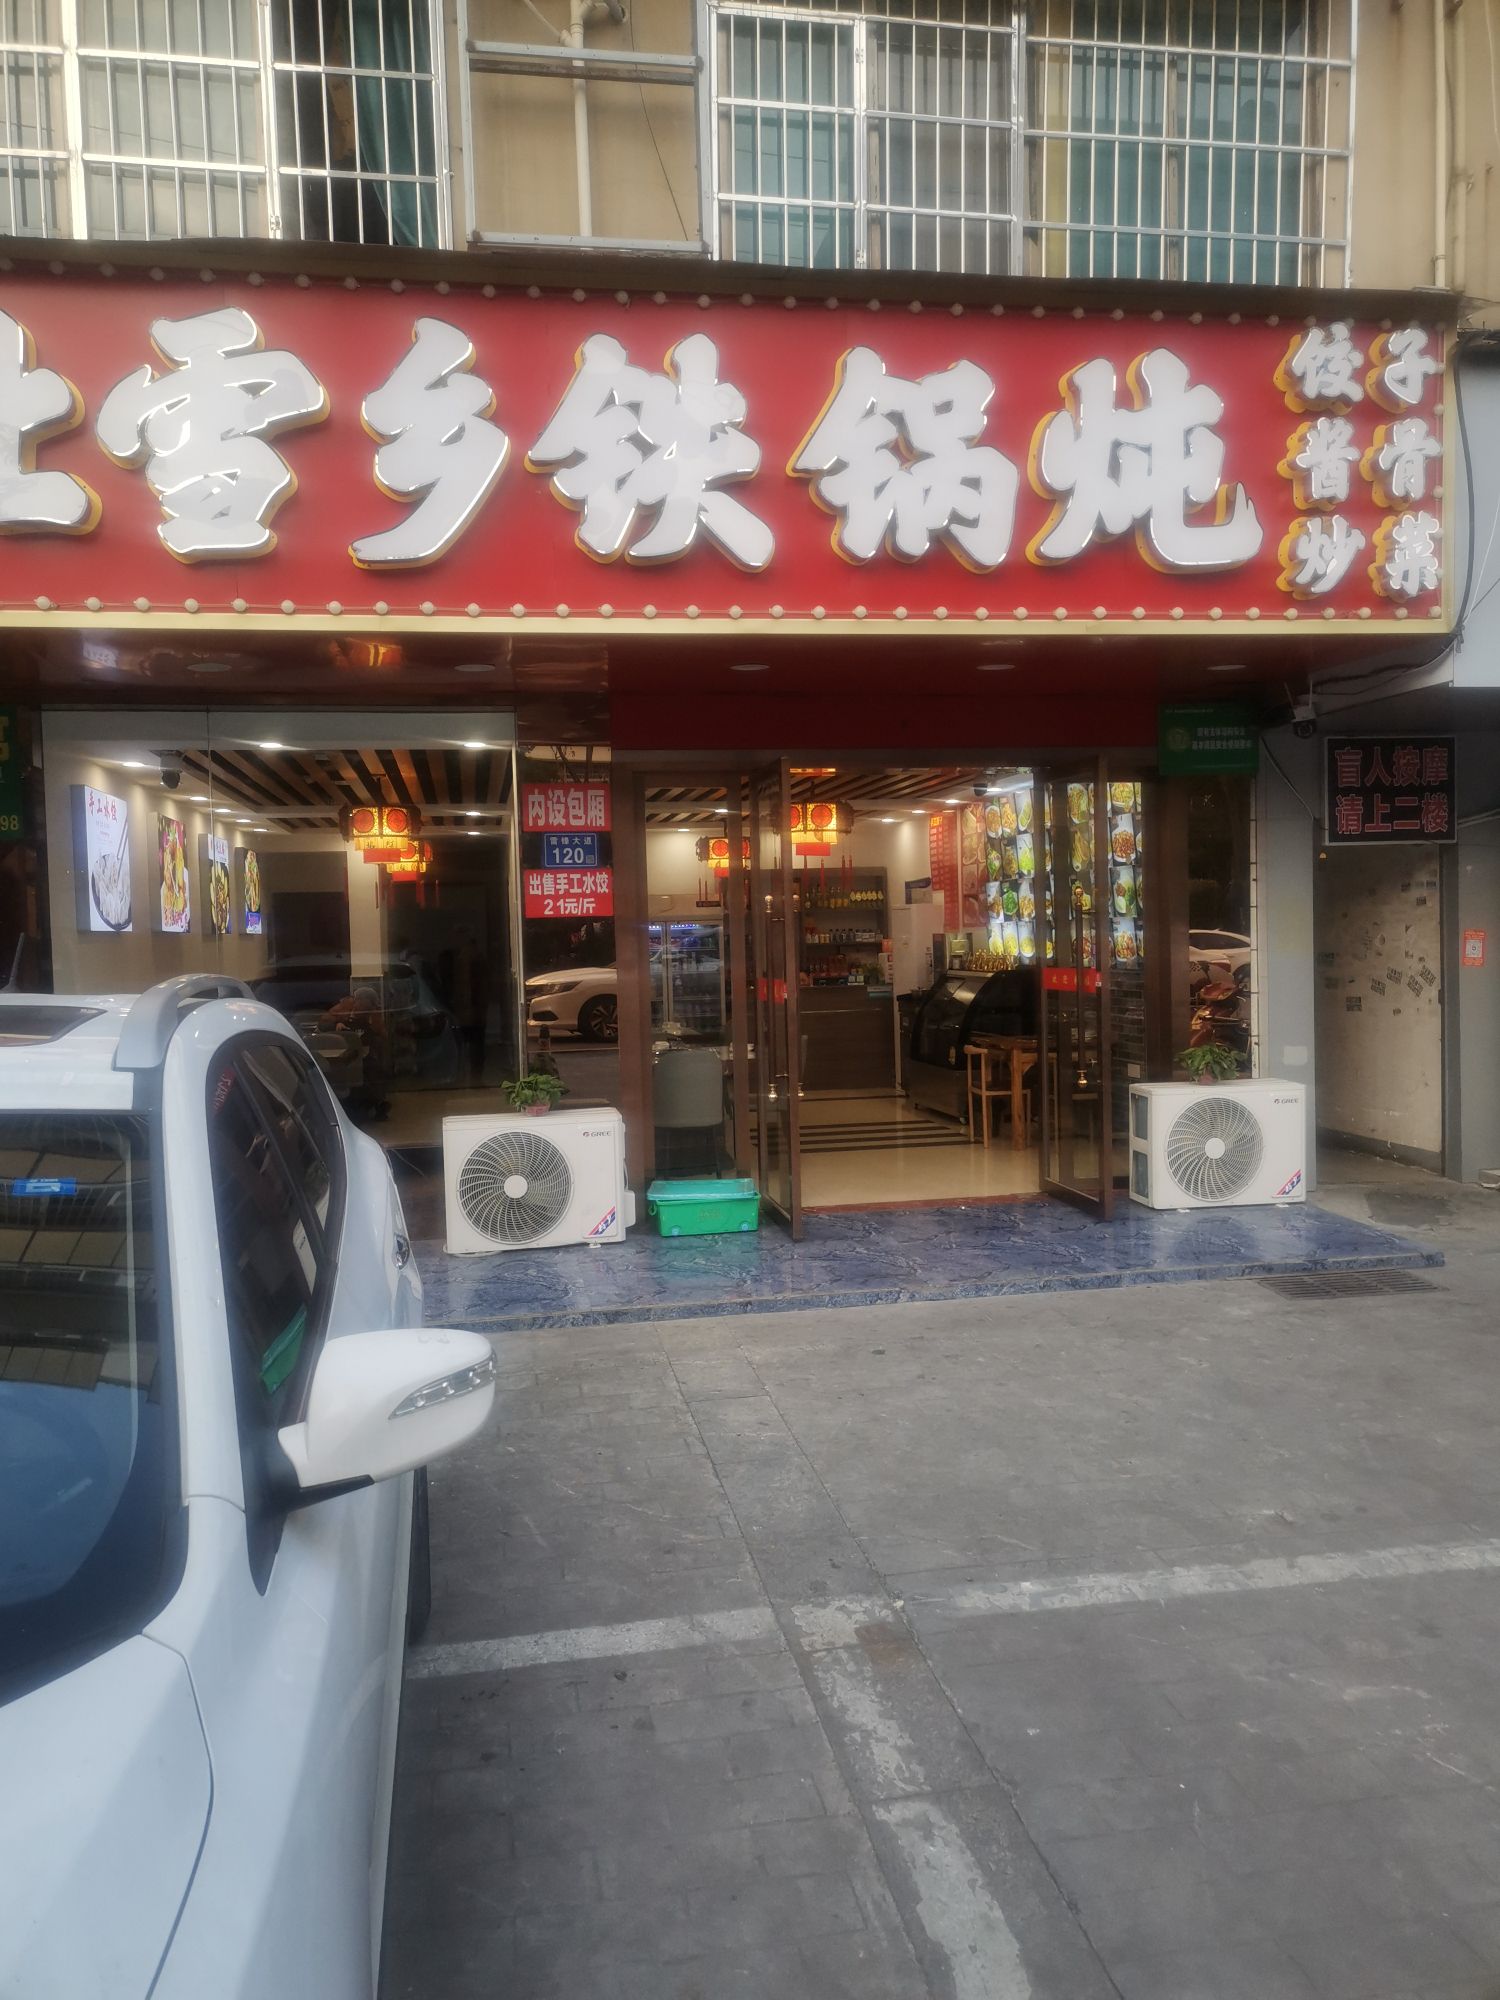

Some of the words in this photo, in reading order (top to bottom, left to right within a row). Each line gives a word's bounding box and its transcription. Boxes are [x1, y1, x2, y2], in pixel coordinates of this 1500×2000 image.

[1275, 322, 1440, 413] 饺子
[1278, 417, 1441, 510] 酱骨
[1277, 511, 1440, 601] 炒菜
[1334, 746, 1449, 788] 盲人按摩
[528, 788, 605, 827] 内设包厢
[1335, 793, 1449, 834] 请上二楼
[552, 847, 584, 864] 120
[529, 872, 609, 896] 出售手工水饺
[544, 898, 596, 916] 21元/斤
